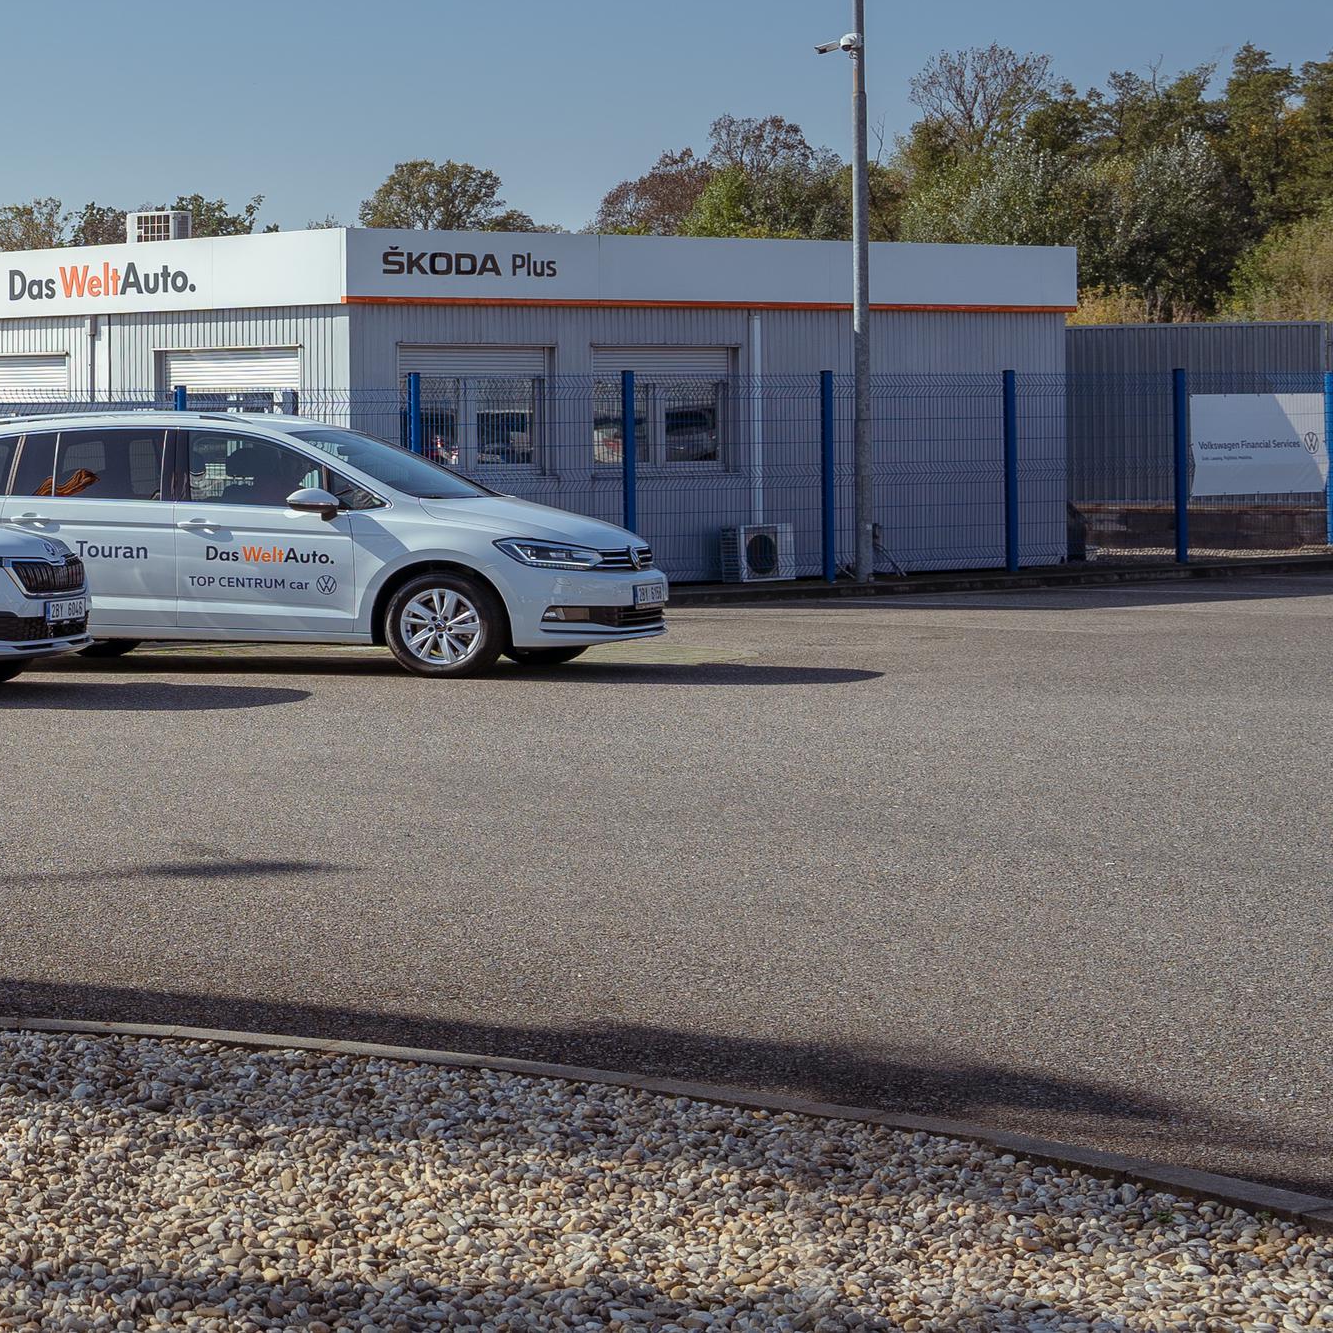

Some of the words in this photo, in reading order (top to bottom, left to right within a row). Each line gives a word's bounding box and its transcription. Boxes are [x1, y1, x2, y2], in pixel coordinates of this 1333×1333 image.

[382, 246, 502, 276] ŠKODA
[511, 252, 558, 277] Plus
[8, 269, 56, 301] Das
[59, 262, 197, 298] WeltAuto.
[1198, 441, 1240, 451] Volkswagen
[1241, 439, 1271, 449] Financial
[1273, 439, 1301, 448] Services
[76, 540, 149, 560] Touran
[205, 546, 239, 562] Das
[242, 546, 335, 565] WeltAuto.
[189, 575, 215, 587] TOP
[218, 575, 286, 589] CENTRUM
[289, 580, 310, 590] car
